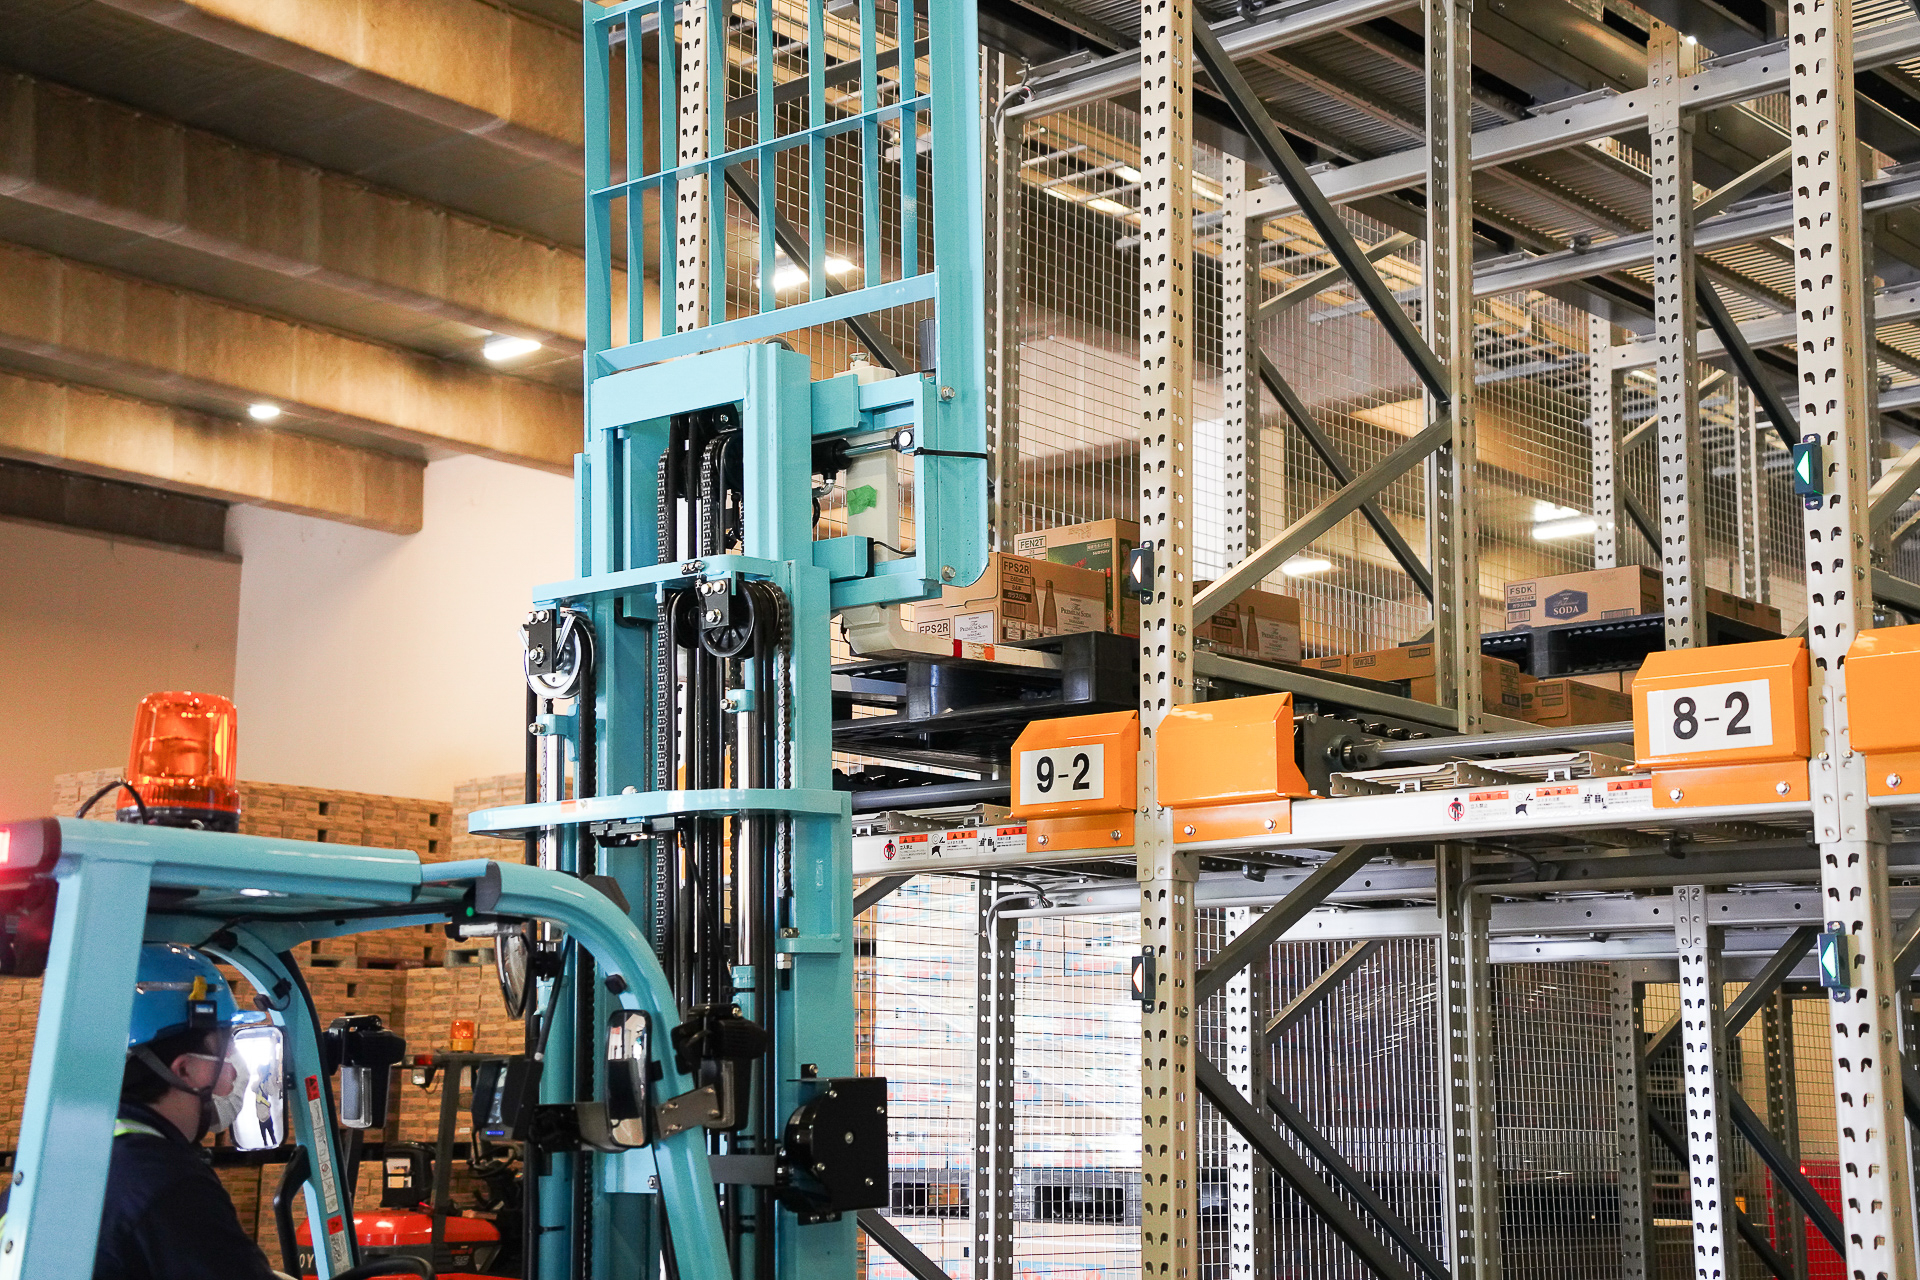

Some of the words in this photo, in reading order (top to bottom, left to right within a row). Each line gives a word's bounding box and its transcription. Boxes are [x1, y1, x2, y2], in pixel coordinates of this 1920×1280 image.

[1020, 538, 1044, 549] FEN2T
[1003, 561, 1030, 575] FPS2R
[1510, 586, 1533, 595] FSDK
[1553, 605, 1580, 616] SODA
[919, 622, 949, 634] FPS2R
[1673, 690, 1752, 740] 8-2
[1036, 752, 1090, 794] 9-2
